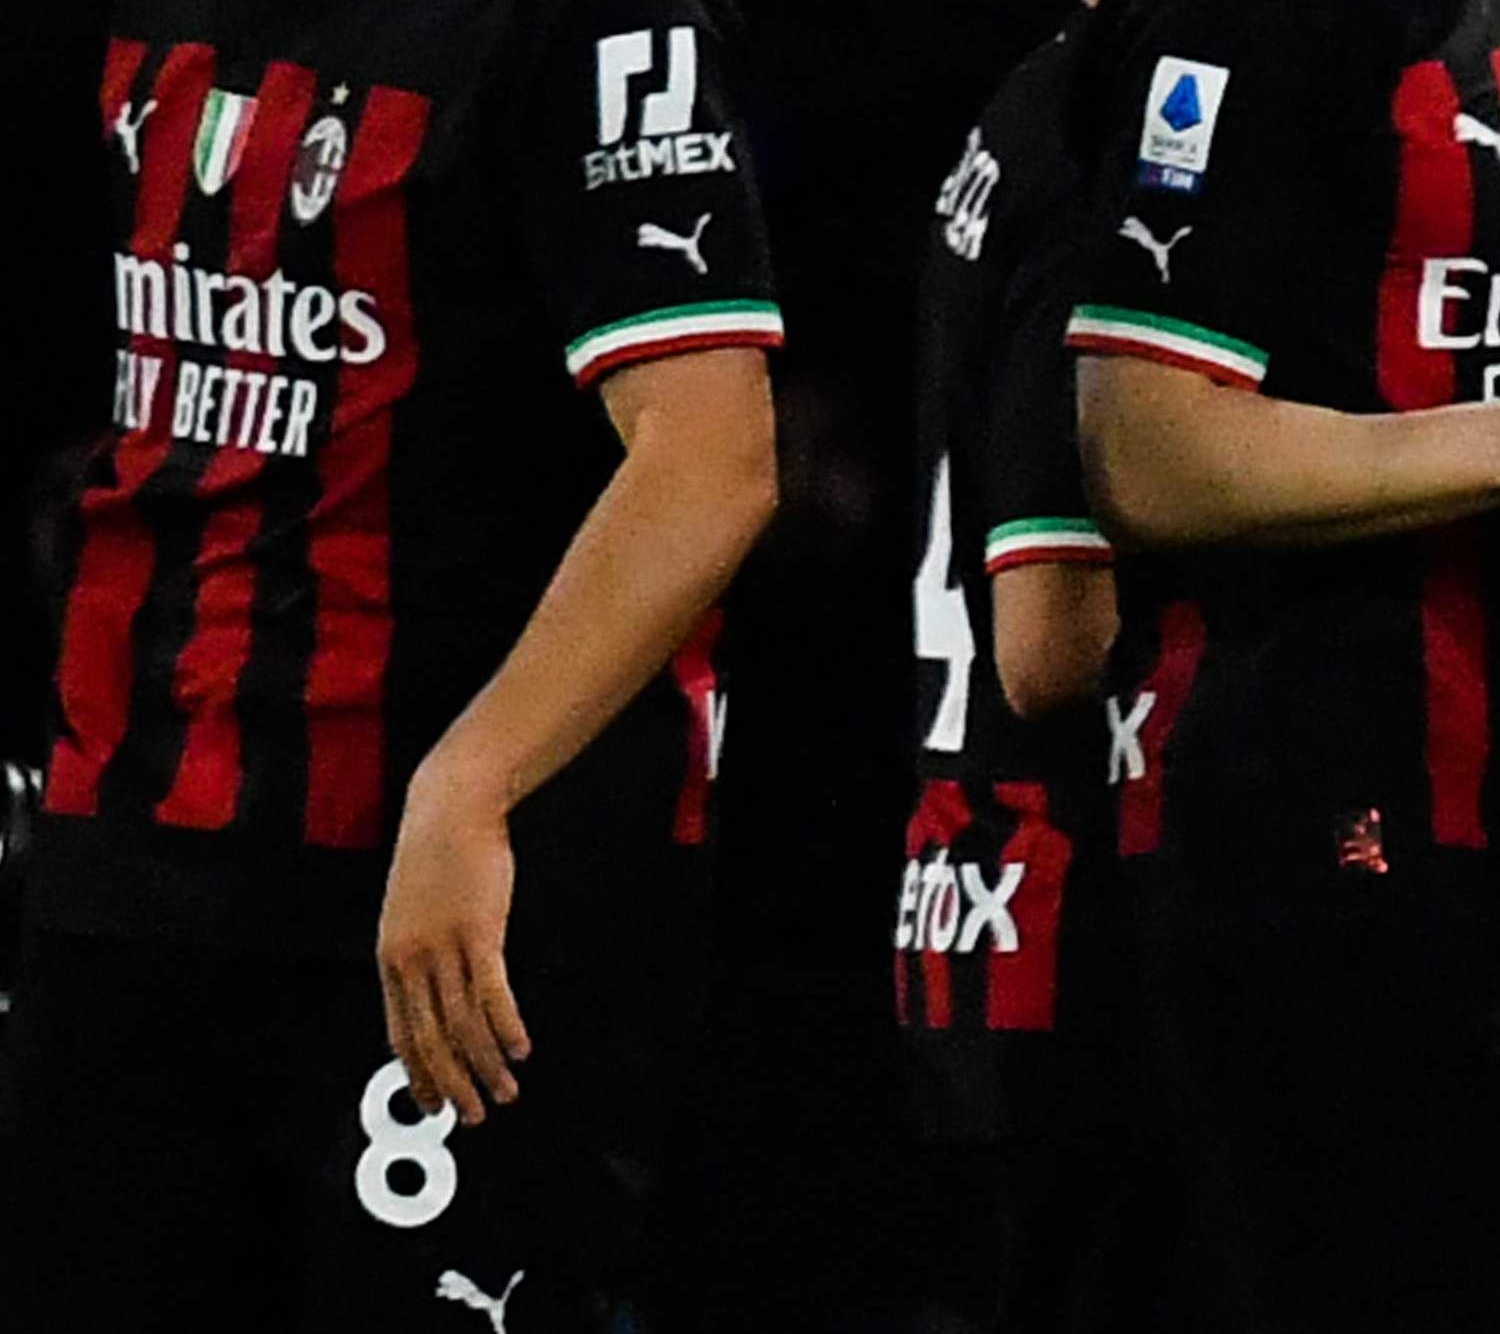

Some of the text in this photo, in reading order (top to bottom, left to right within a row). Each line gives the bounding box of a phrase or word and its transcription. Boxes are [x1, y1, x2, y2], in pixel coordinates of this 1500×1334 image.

[584, 131, 736, 190] BitMEX
[171, 360, 318, 457] BETTER
[353, 1057, 460, 1230] 8
